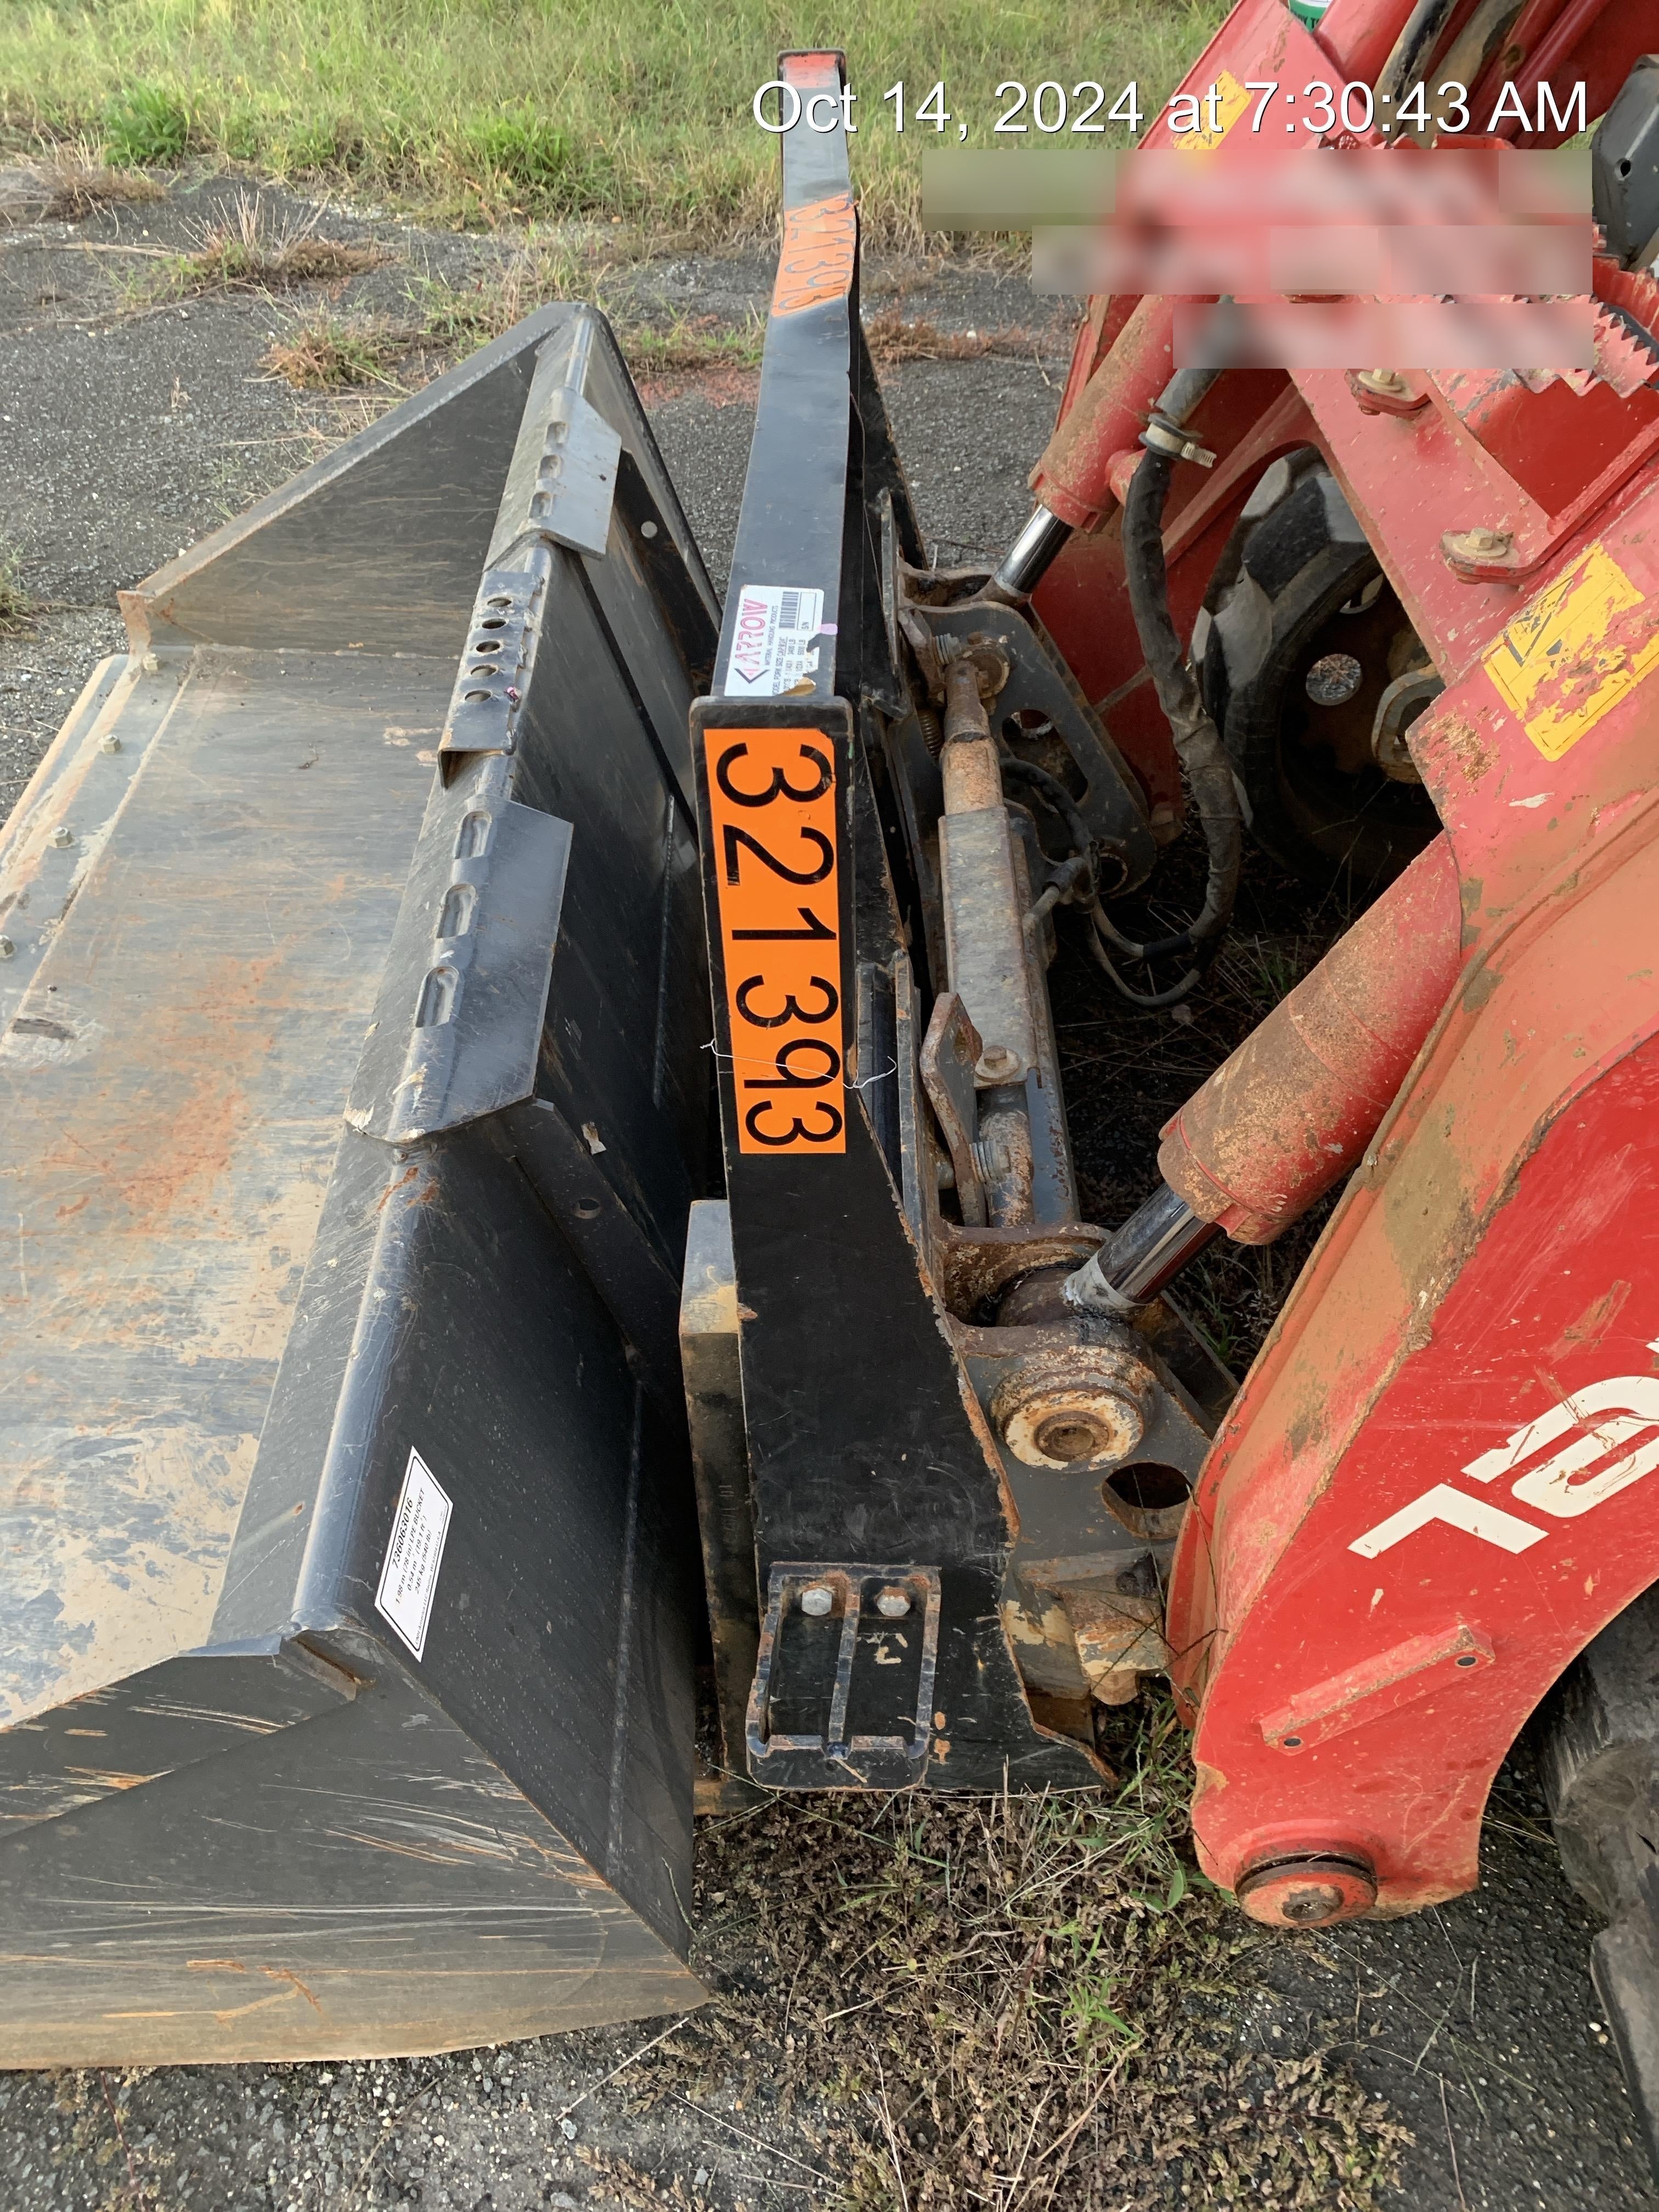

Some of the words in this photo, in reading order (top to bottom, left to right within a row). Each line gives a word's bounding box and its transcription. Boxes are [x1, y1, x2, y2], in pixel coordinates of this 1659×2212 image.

[735, 599, 768, 665] ARROW
[715, 742, 843, 1148] 321393
[392, 1497, 413, 1569] 736063016
[401, 1575, 406, 1584] m
[413, 1487, 425, 1525] BUCKET
[419, 1564, 425, 1576] kg
